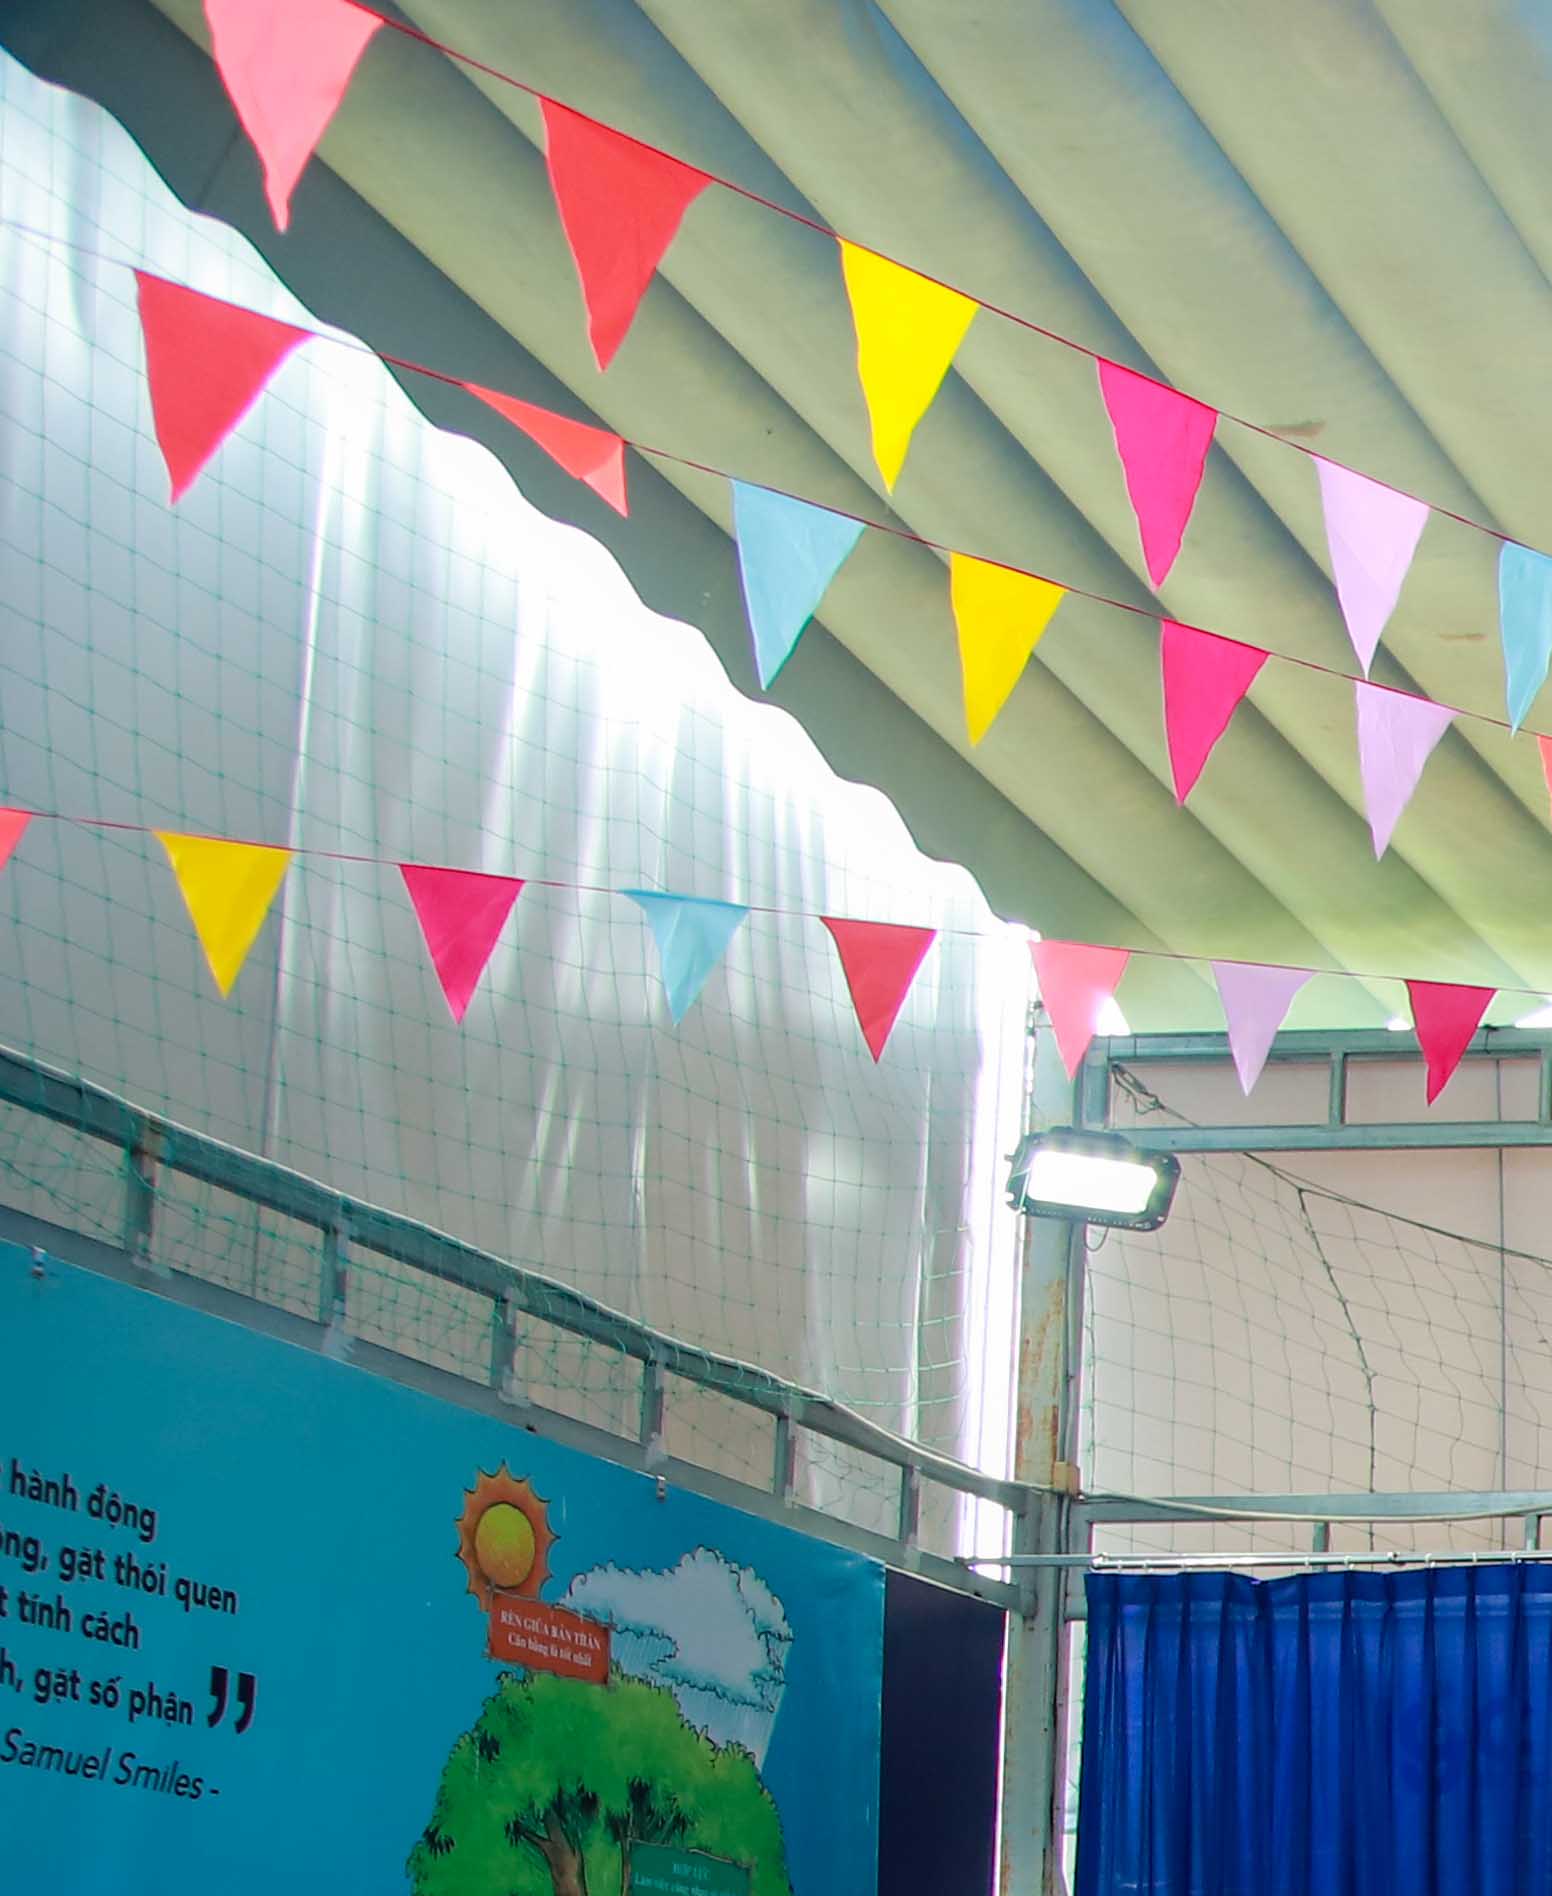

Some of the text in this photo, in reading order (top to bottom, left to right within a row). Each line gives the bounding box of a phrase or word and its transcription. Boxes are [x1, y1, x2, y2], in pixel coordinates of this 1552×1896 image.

[10, 1458, 157, 1542] hành động
[0, 1524, 237, 1615] ng, gặt thói quen
[18, 1588, 72, 1633] tính
[81, 1610, 140, 1649] cách
[34, 1666, 194, 1727] gặt số phận
[0, 1727, 204, 1801] Samuel Smiles
